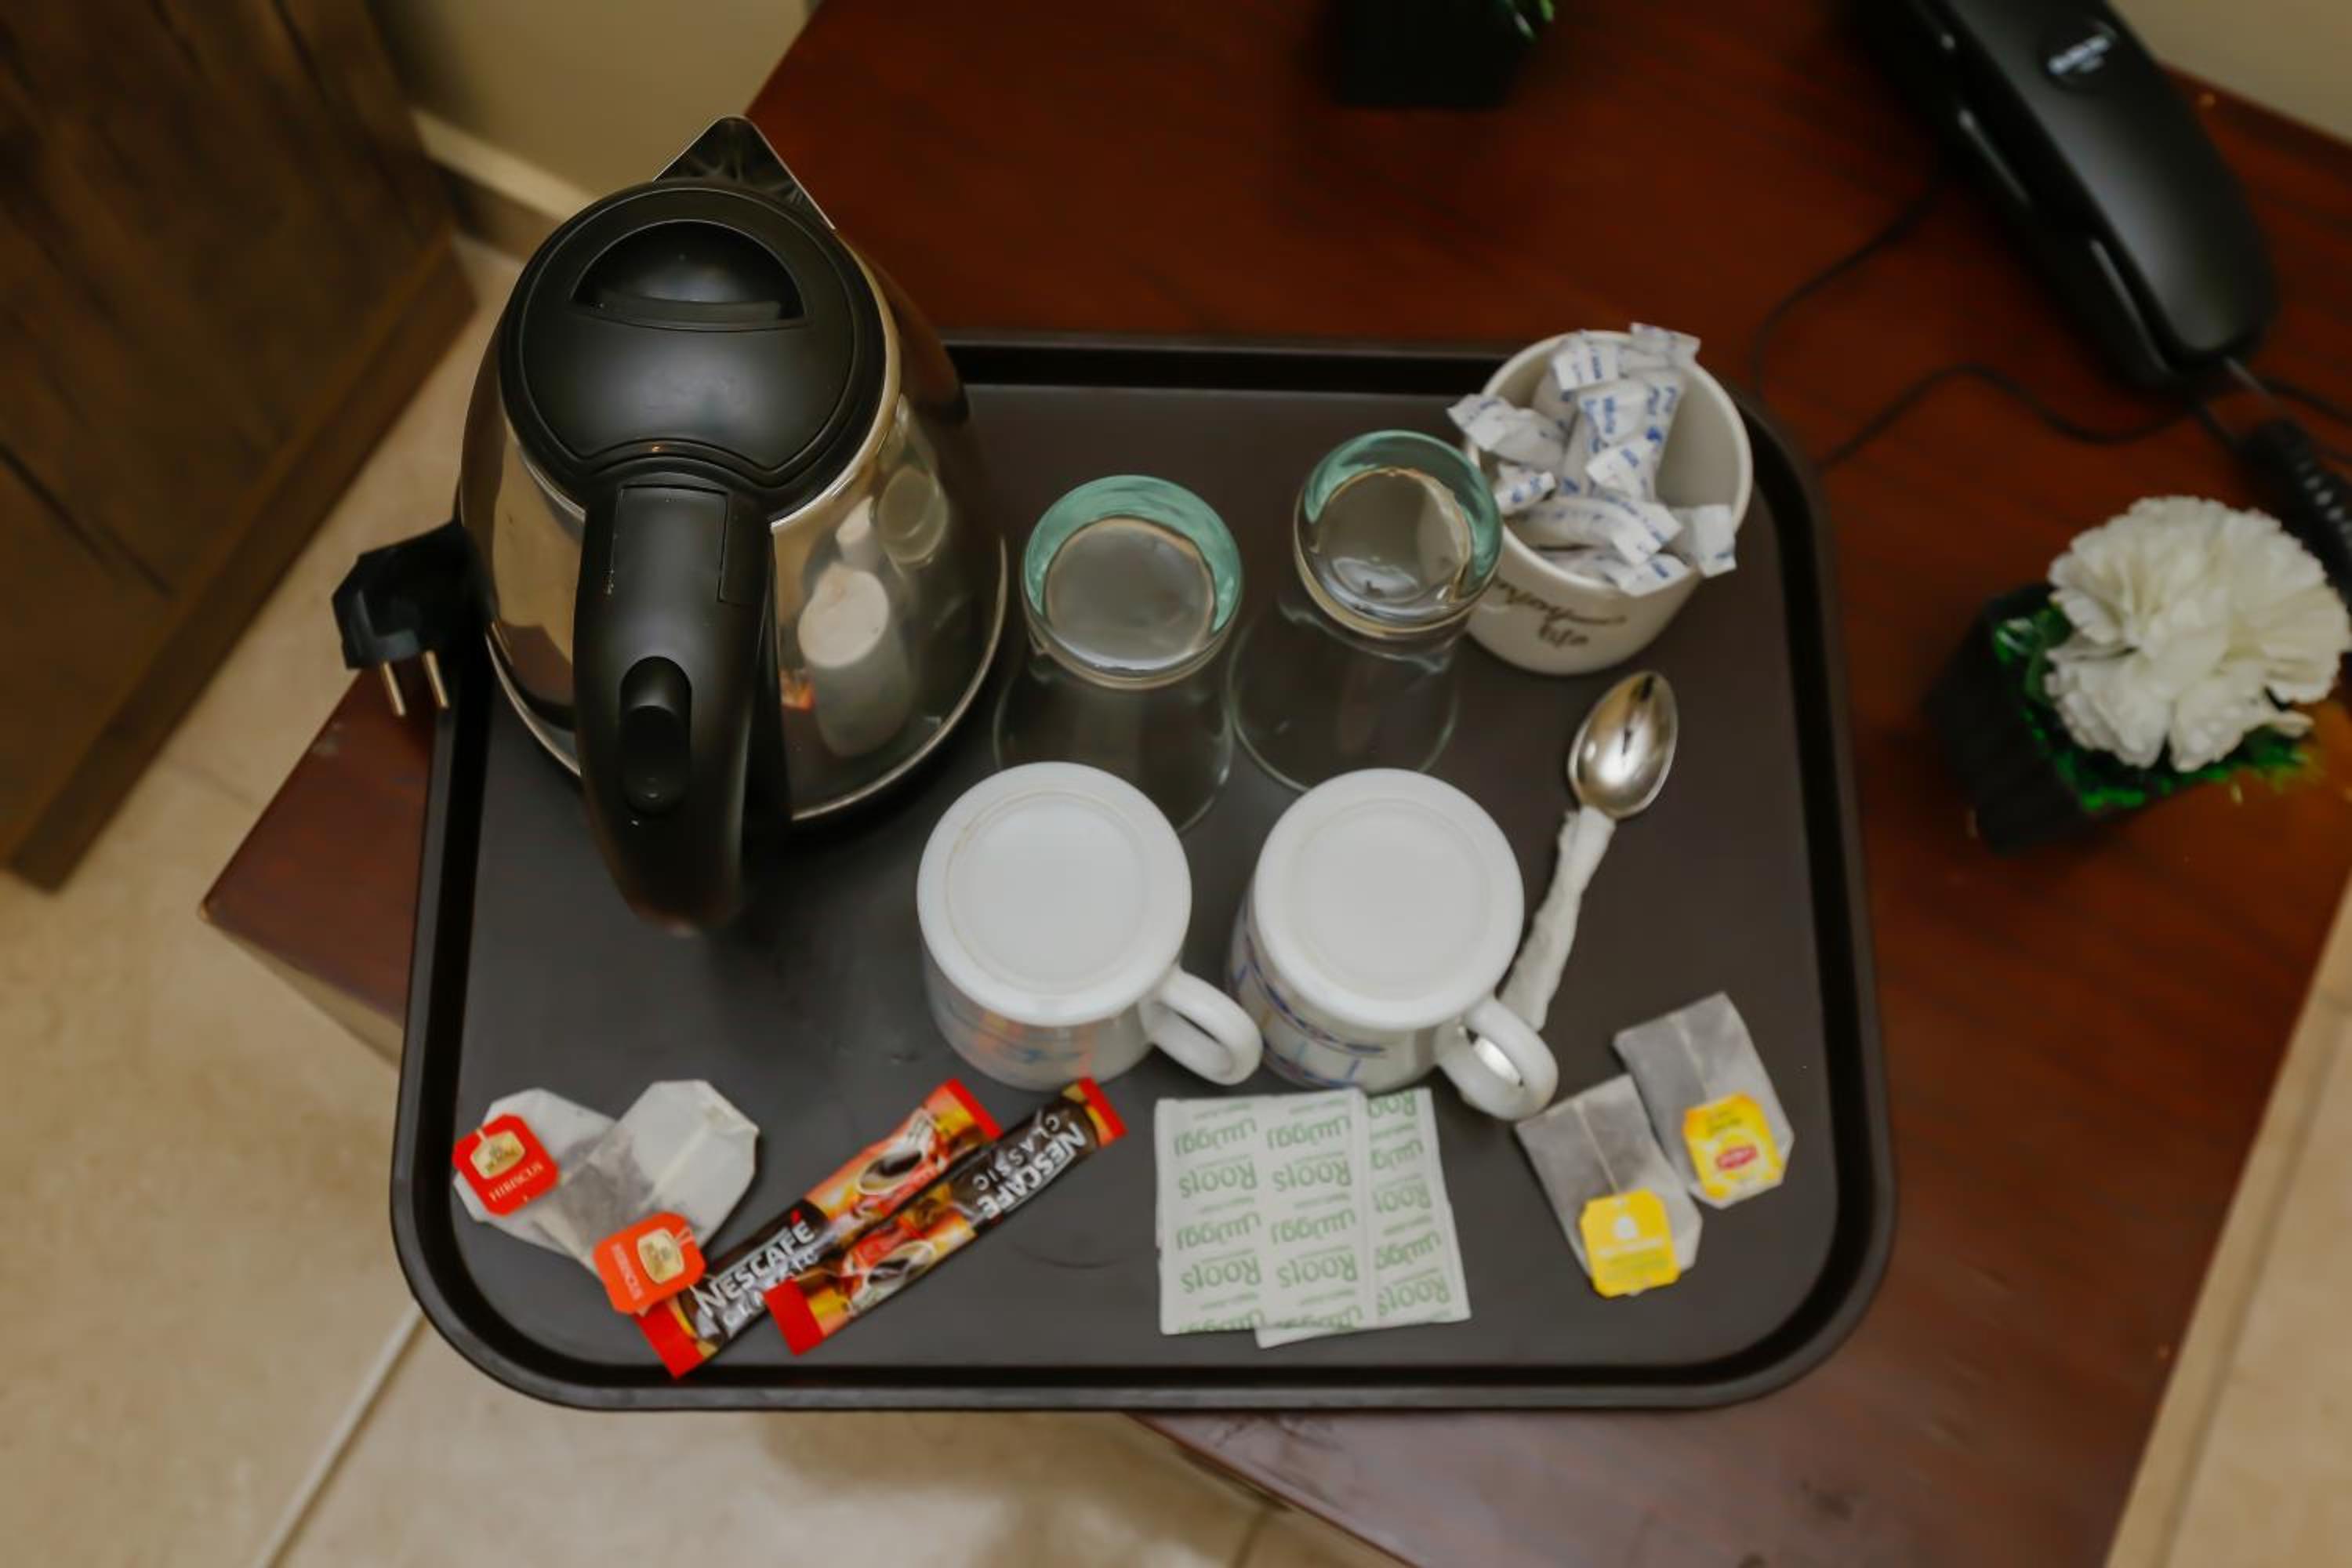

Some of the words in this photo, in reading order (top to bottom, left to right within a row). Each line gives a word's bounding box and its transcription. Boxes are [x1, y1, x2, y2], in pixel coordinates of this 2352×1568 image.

[972, 1114, 1061, 1192] CLASSIC
[1178, 1160, 1258, 1200] Roots
[1272, 1157, 1352, 1193] Roots
[1179, 1255, 1261, 1294] Roots
[1276, 1253, 1359, 1289] Roots
